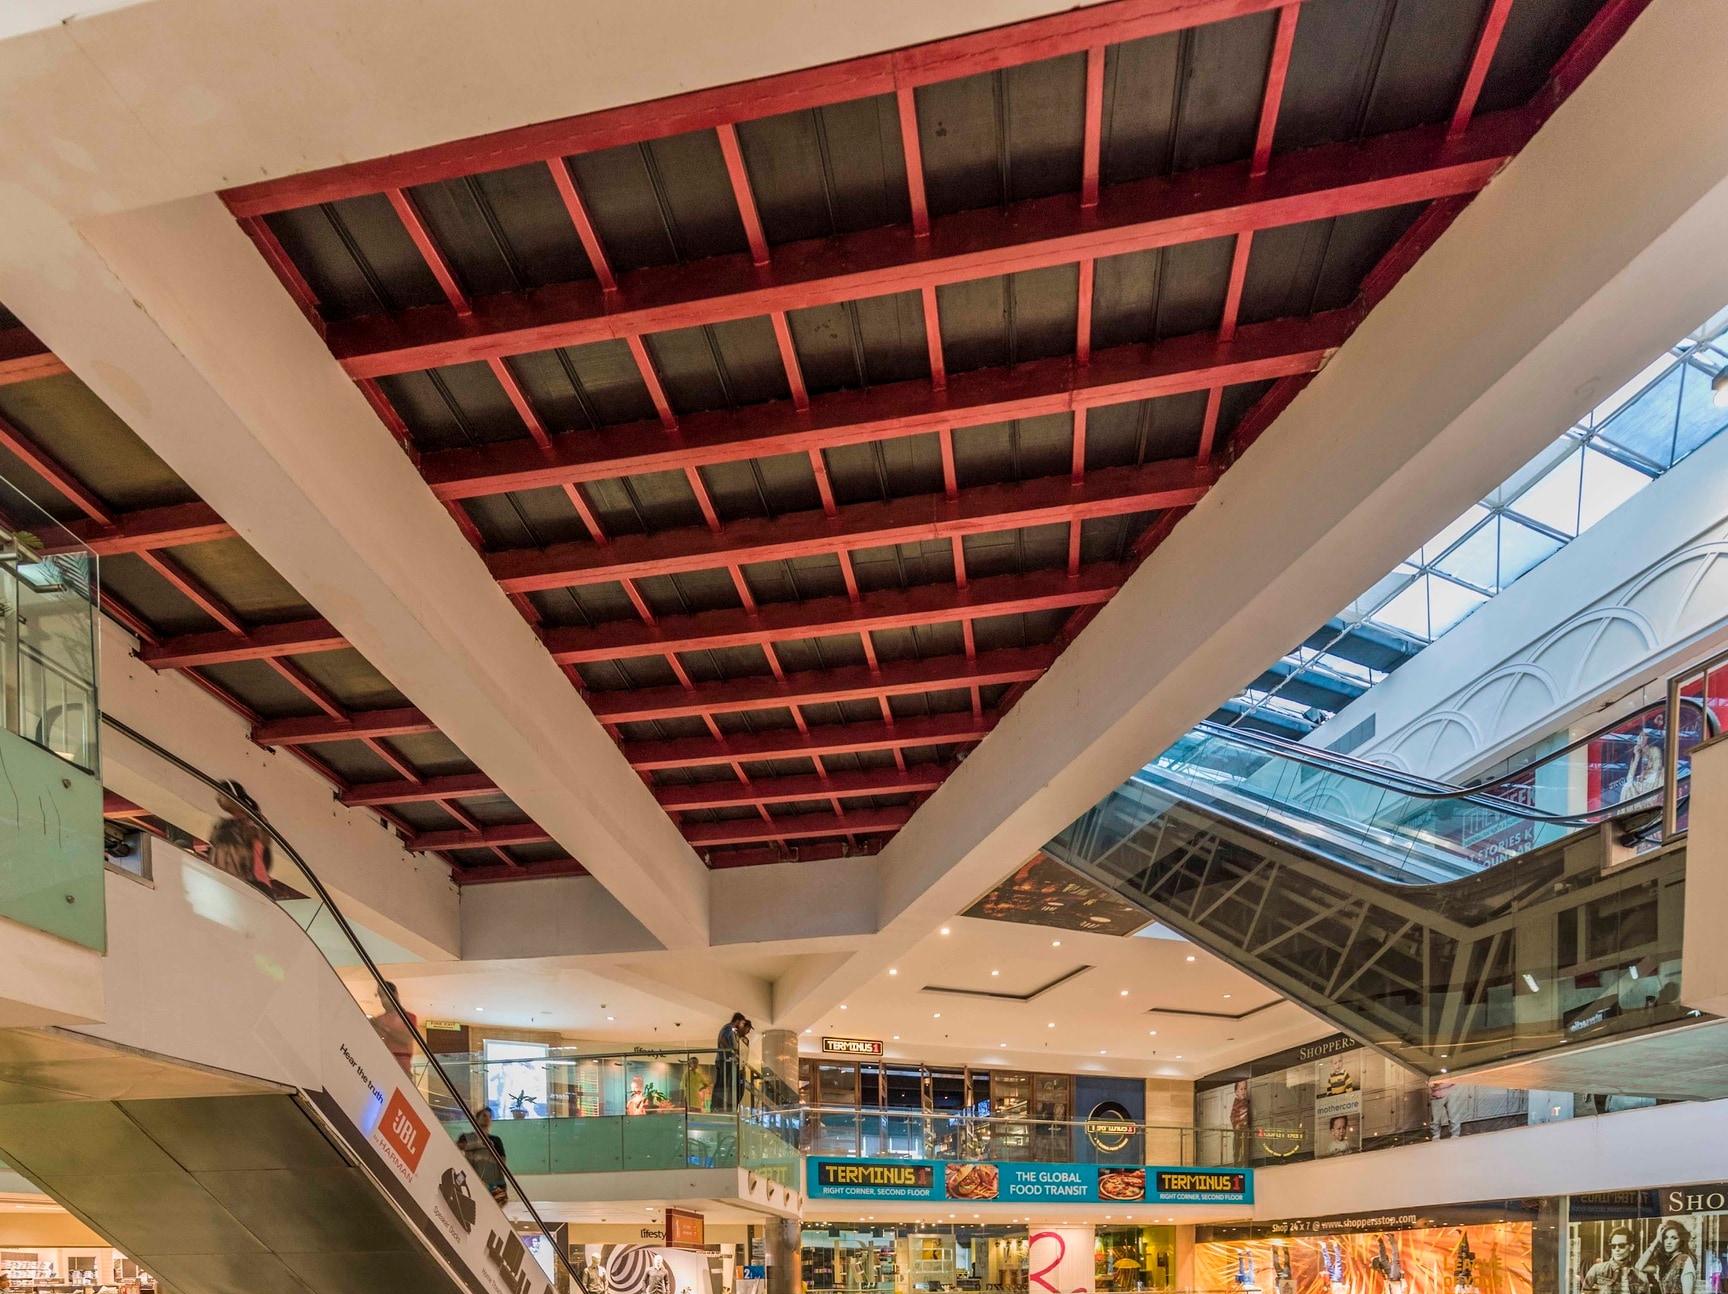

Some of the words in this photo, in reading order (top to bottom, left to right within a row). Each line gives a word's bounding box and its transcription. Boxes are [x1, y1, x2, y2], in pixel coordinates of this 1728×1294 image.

[827, 1040, 873, 1053] TERMINUS
[1300, 1036, 1356, 1061] SHOPPERS
[339, 1043, 358, 1068] Hear
[356, 1065, 369, 1083] the
[367, 1080, 385, 1105] truth
[1317, 1101, 1360, 1115] mothercare
[392, 1108, 418, 1155] JBL
[379, 1140, 413, 1184] HARMAN
[825, 1165, 916, 1185] TERMINUS
[1015, 1171, 1037, 1182] THE
[1038, 1171, 1082, 1183] GLOBAL
[1161, 1173, 1232, 1191] TERMINUS
[822, 1187, 844, 1195] RIGHT
[845, 1187, 876, 1196] CORNER,
[877, 1188, 906, 1196] SECOND
[907, 1188, 930, 1196] FLOOR
[1009, 1184, 1043, 1195] FOOD
[1044, 1185, 1088, 1196] TRANSIT
[1178, 1193, 1200, 1201] CORNER,
[1668, 1191, 1725, 1212] SHO
[1271, 1223, 1288, 1233] Shop
[1289, 1222, 1299, 1232] 24
[1305, 1222, 1311, 1231] 7
[1312, 1220, 1320, 1232] @
[1321, 1214, 1417, 1229] www.shoppersstop.com
[1443, 1256, 1503, 1272] LEAGUE
